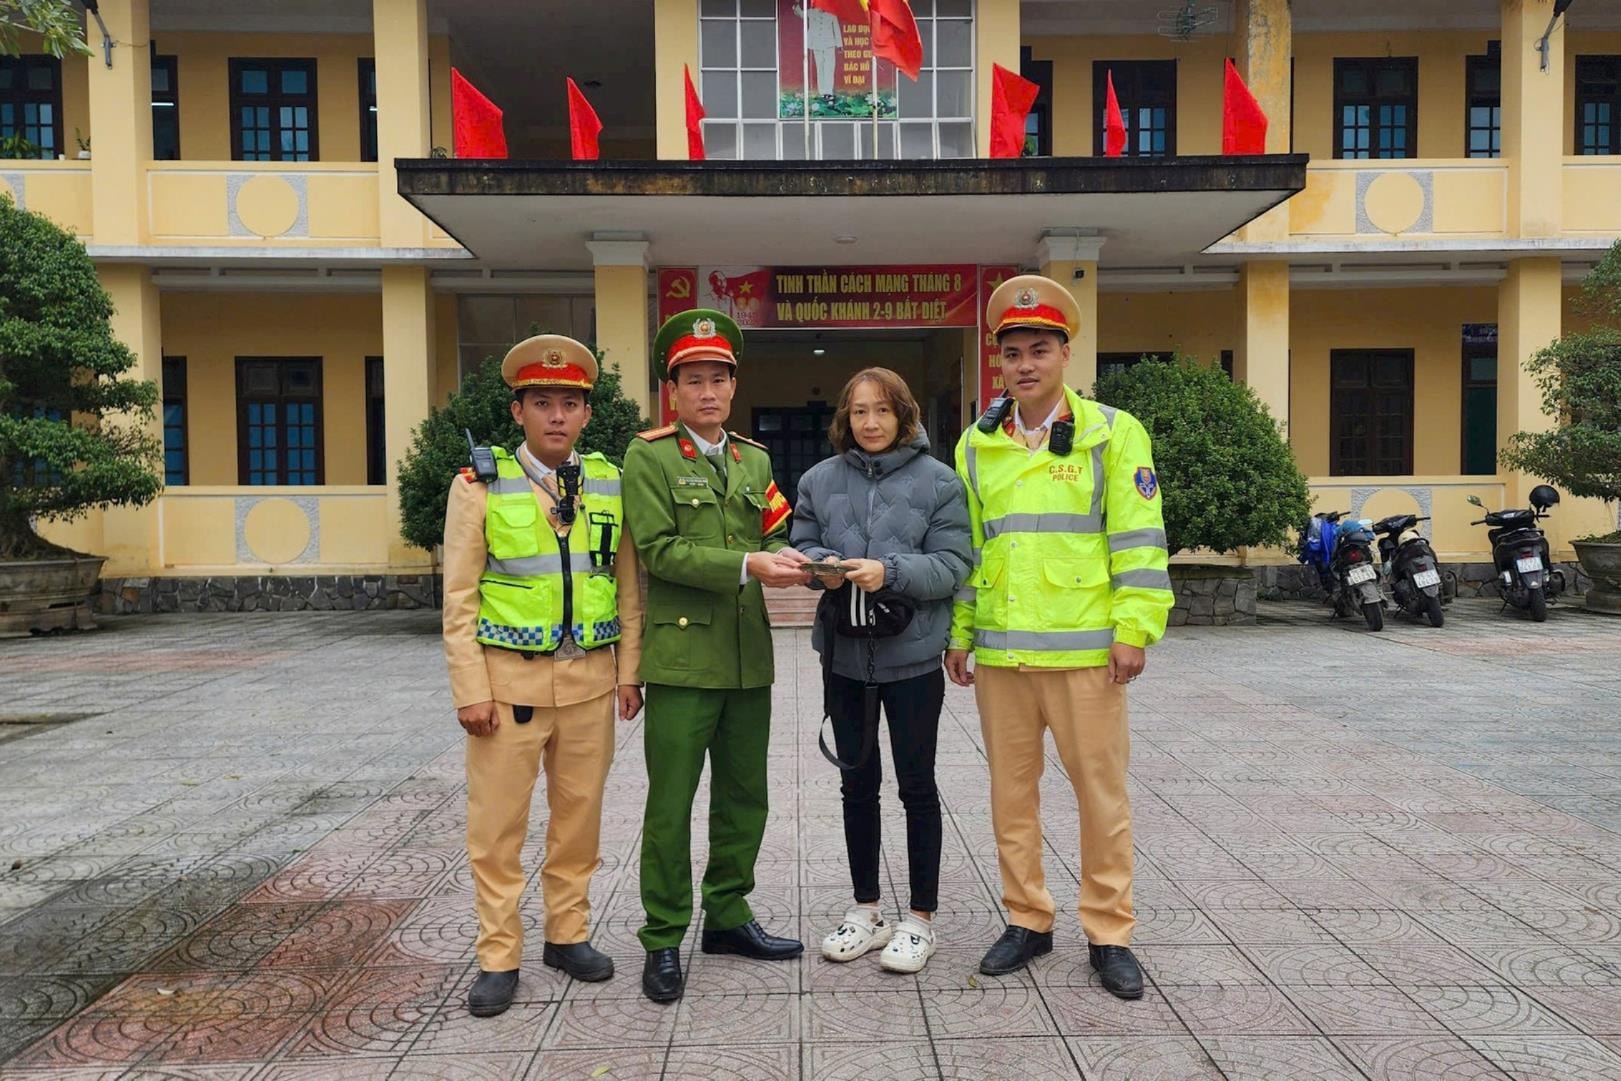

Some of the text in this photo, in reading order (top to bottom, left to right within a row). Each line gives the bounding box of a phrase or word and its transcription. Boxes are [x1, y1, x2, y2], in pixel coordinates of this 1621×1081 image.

[843, 25, 857, 33] LAO
[843, 36, 869, 47] VÀ HỌC
[844, 50, 861, 59] THEO
[843, 61, 859, 71] BÁC
[776, 268, 962, 296] TINH THẦN CÁCH MẠNG THÁNG 8
[776, 295, 946, 323] VÀ QUỐC KHÁNH 2-9 BẤT DIỆT
